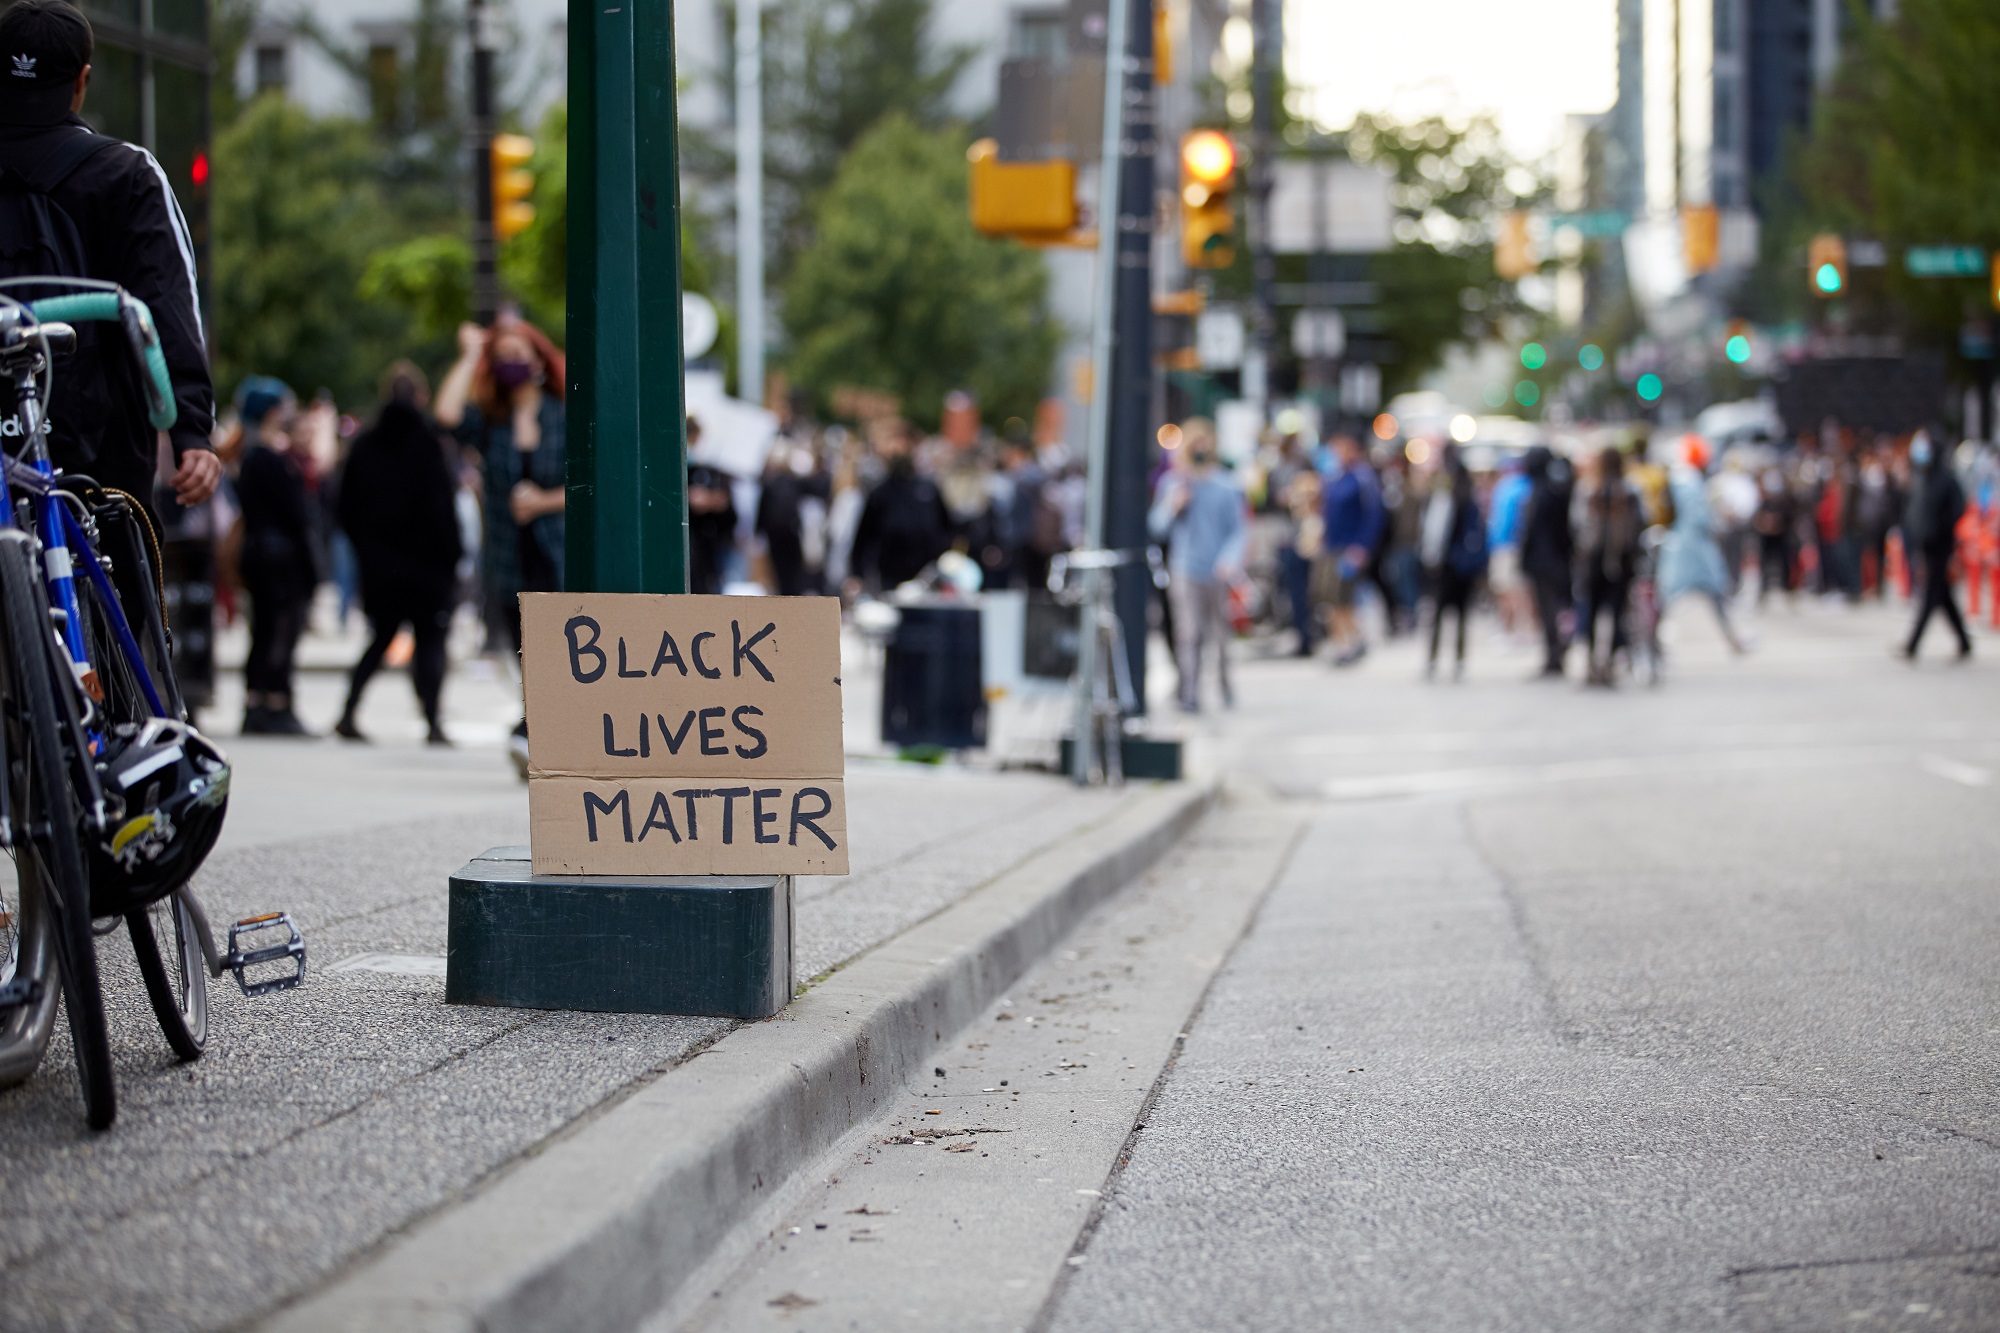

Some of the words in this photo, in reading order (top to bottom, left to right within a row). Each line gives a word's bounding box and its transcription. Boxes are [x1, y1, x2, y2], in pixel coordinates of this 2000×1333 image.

[564, 615, 776, 684] BLACK
[603, 705, 768, 760] LIVES
[583, 787, 838, 851] MATTER
